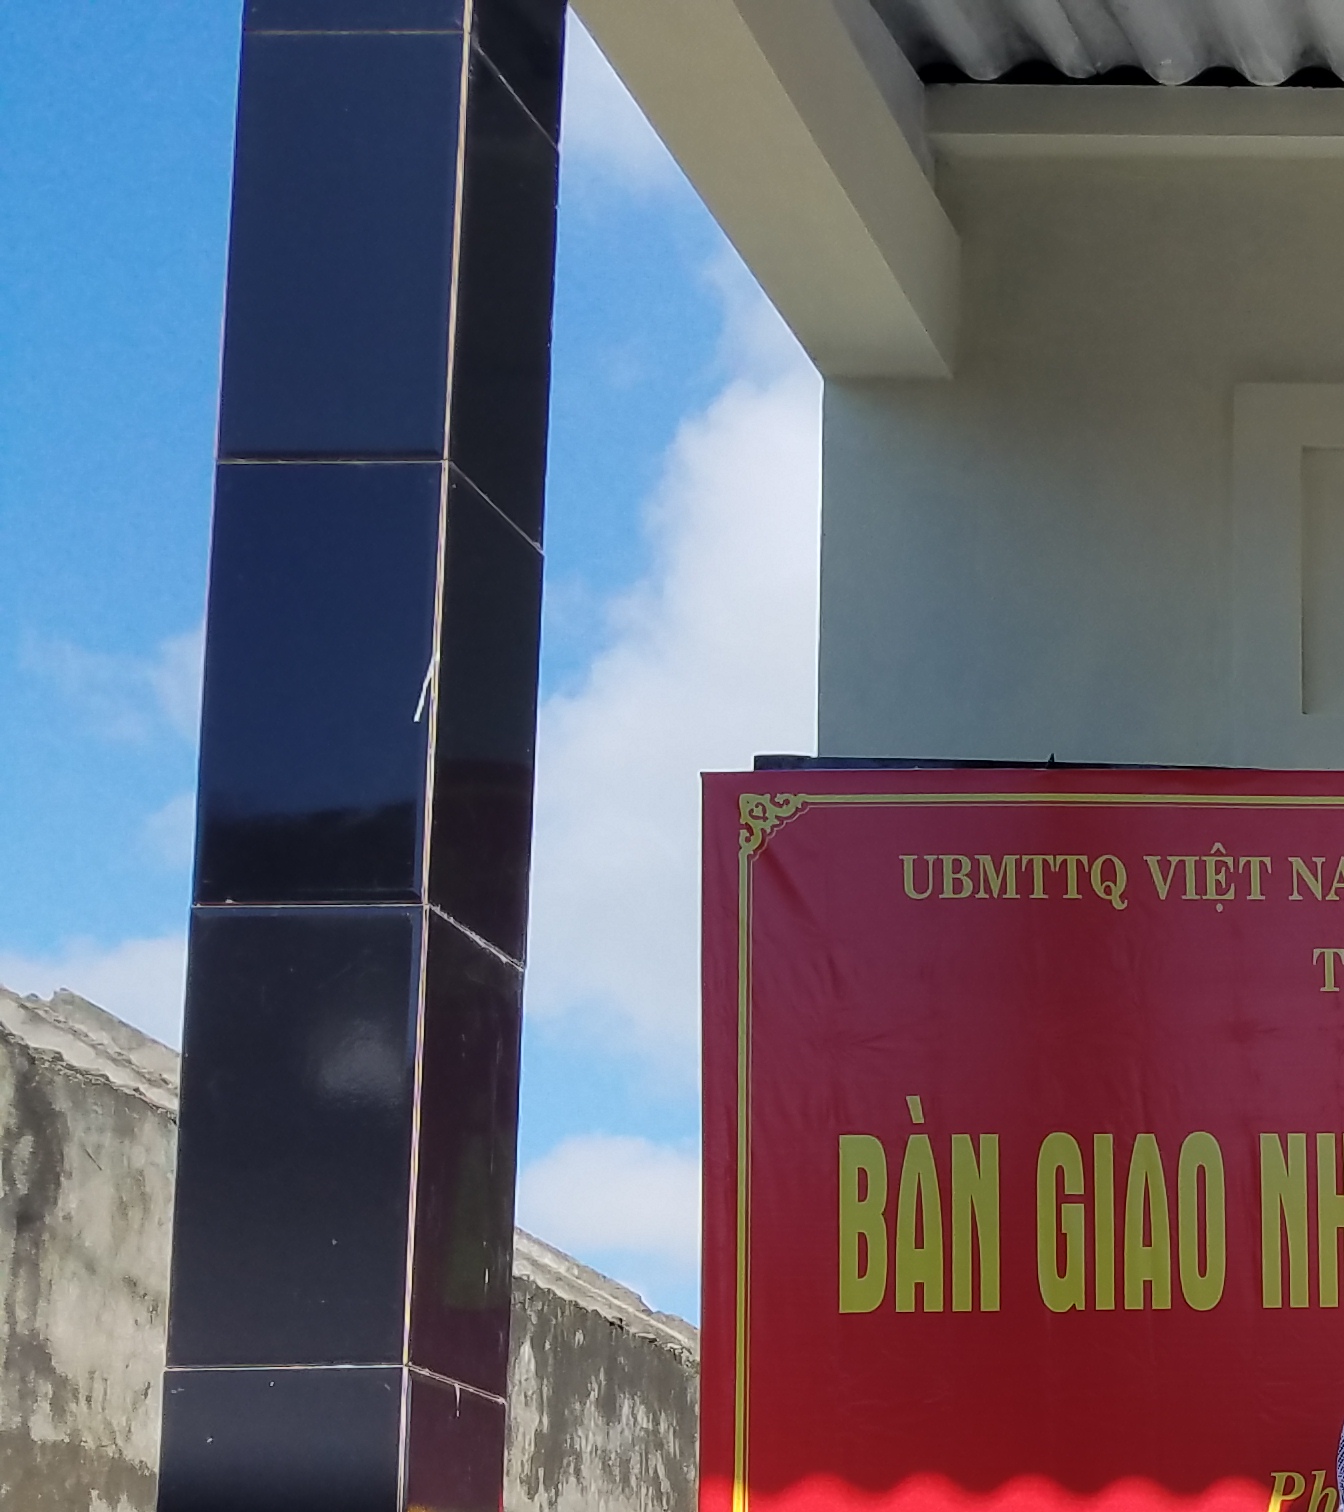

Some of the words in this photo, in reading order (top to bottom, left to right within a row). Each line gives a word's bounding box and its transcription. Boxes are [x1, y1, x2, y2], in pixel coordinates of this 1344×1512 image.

[901, 853, 1128, 910] UBMTTQ
[1145, 843, 1272, 914] VIỆT
[838, 1095, 1001, 1314] BÀN
[1035, 1131, 1227, 1313] GIAO
